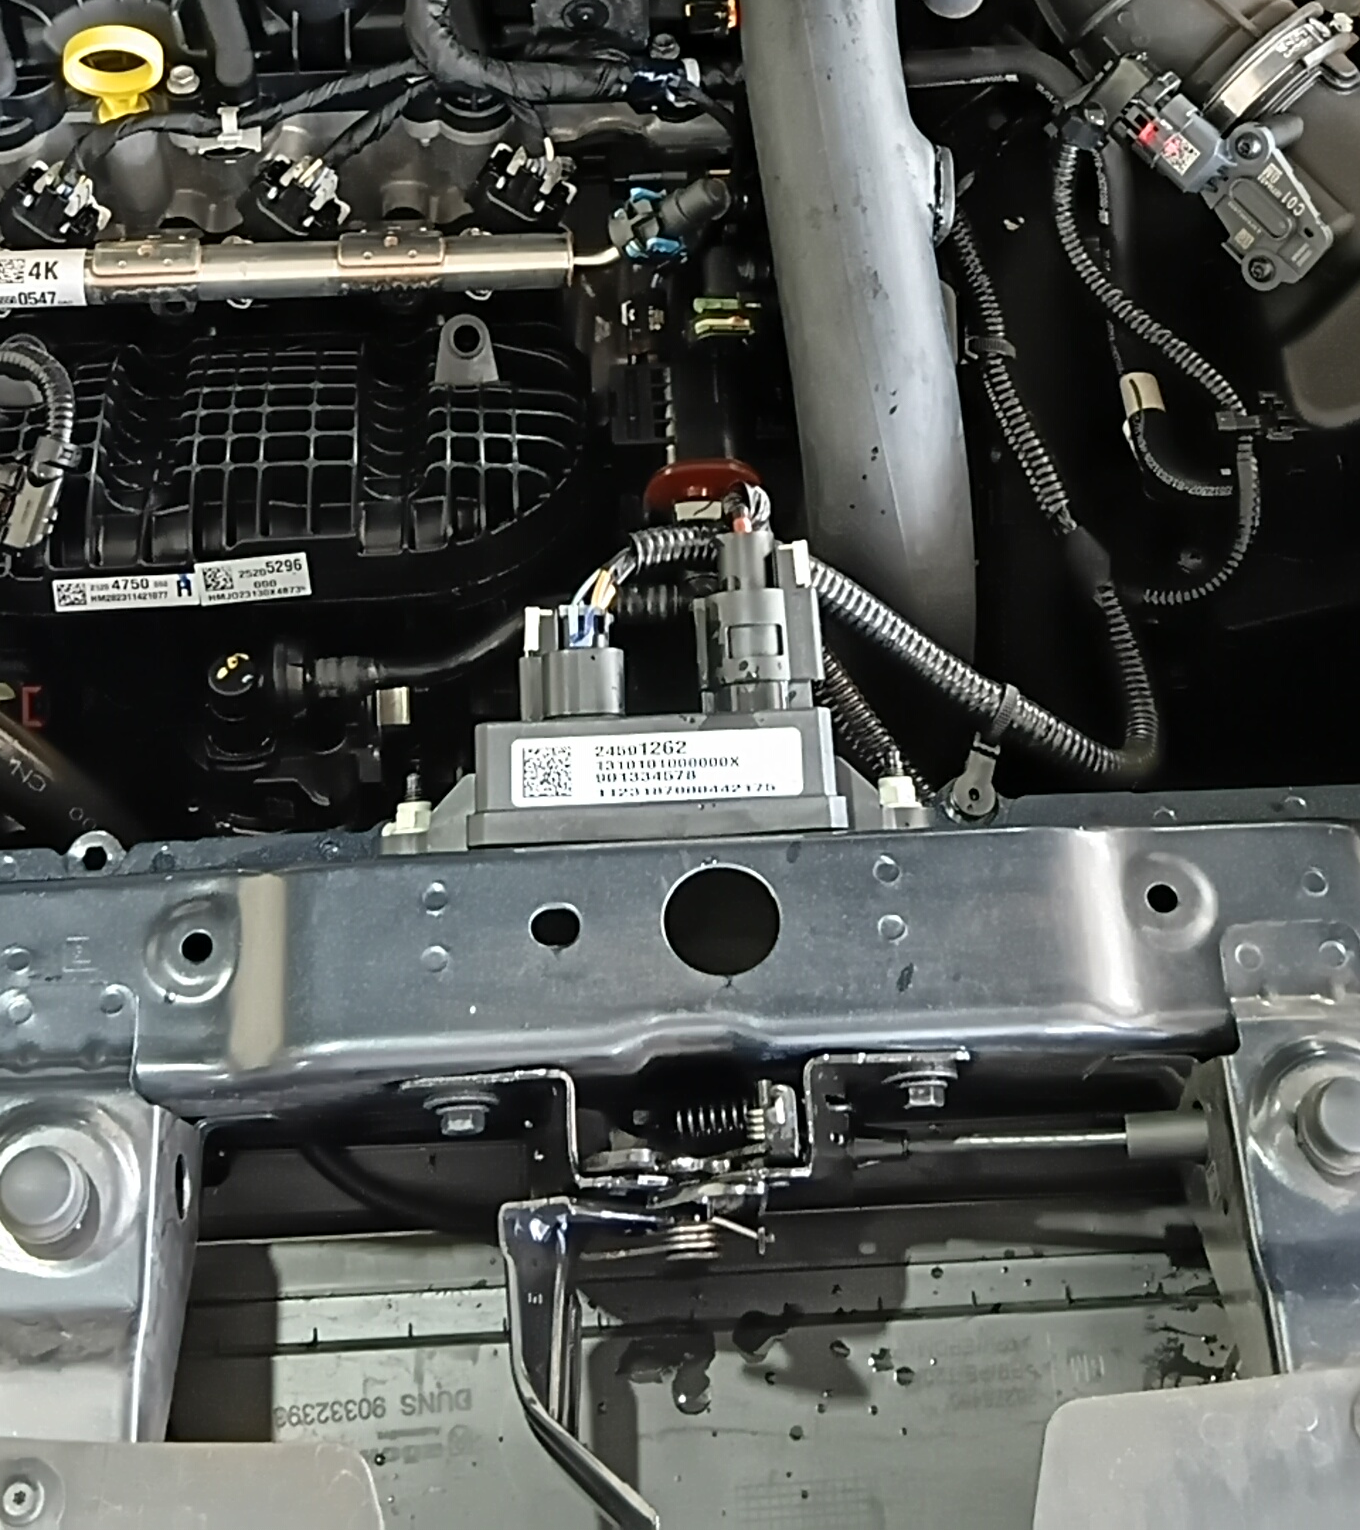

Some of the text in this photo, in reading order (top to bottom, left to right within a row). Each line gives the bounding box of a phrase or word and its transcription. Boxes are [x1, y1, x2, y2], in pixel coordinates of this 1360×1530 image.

[28, 260, 59, 280] 4K
[111, 577, 150, 590] 4750
[400, 1388, 472, 1416] DUNS
